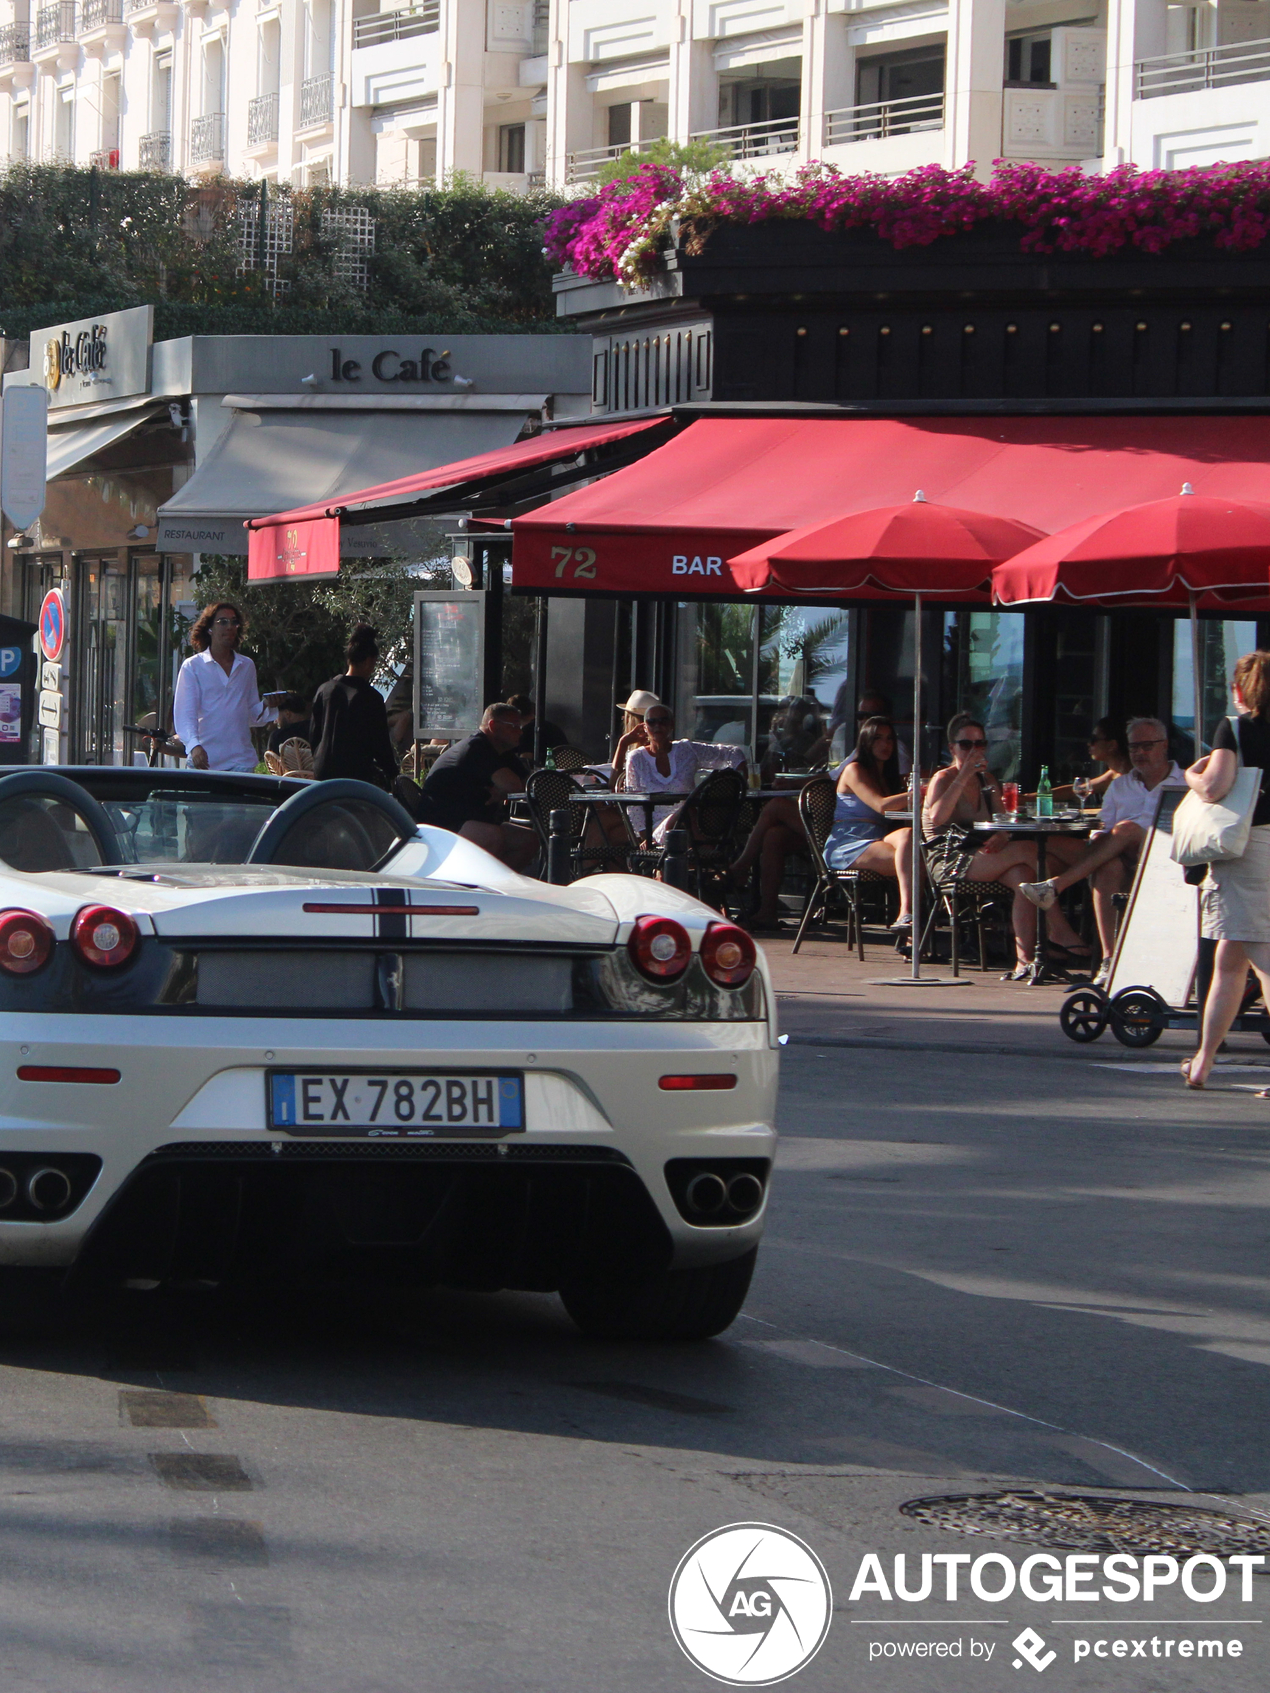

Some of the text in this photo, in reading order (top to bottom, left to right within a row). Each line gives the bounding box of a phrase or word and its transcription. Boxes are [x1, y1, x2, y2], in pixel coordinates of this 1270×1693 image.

[330, 348, 450, 381] le Café
[164, 529, 225, 541] RESTAURANT
[347, 537, 378, 549] Vesuvio
[550, 546, 597, 579] 72
[672, 555, 723, 576] BAR
[0, 650, 15, 672] P
[301, 1078, 495, 1122] EX 782BH
